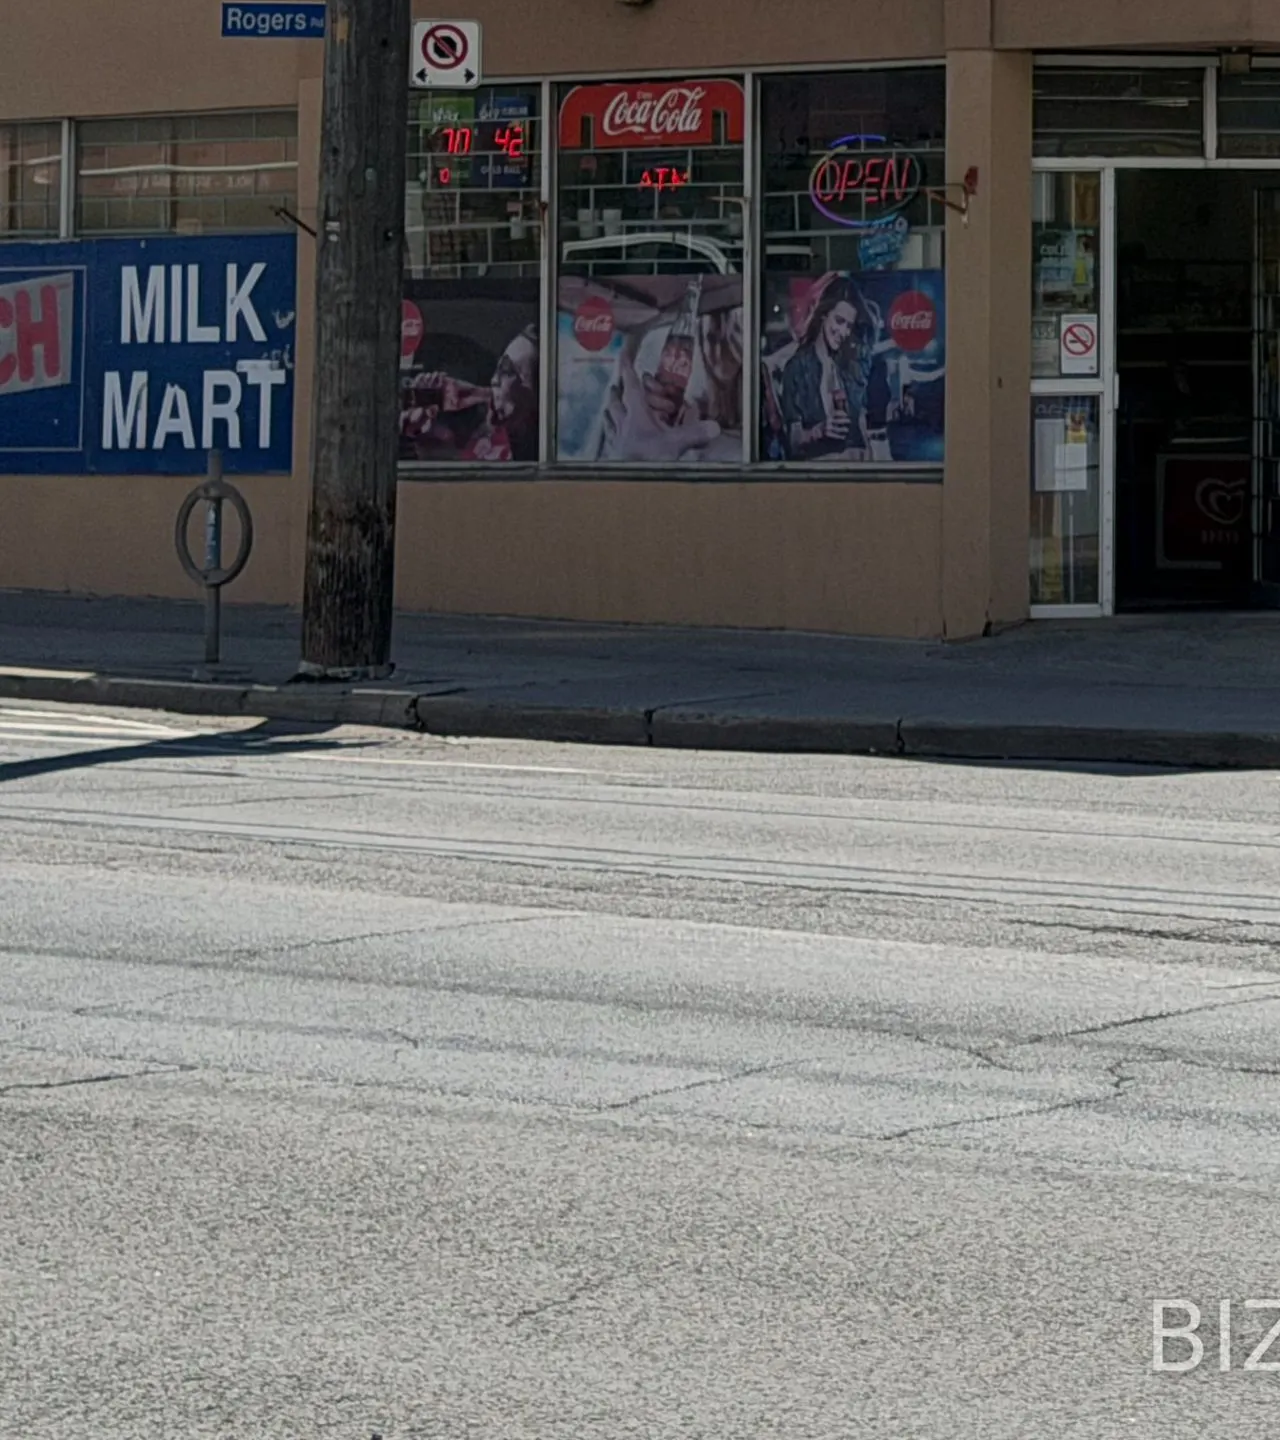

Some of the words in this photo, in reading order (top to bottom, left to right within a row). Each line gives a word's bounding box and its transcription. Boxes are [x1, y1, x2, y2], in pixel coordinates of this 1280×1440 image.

[226, 7, 307, 34] Rogers
[602, 86, 706, 136] Coca-Cola
[816, 158, 912, 202] OPEN
[120, 262, 268, 344] MILK
[102, 360, 286, 449] MART
